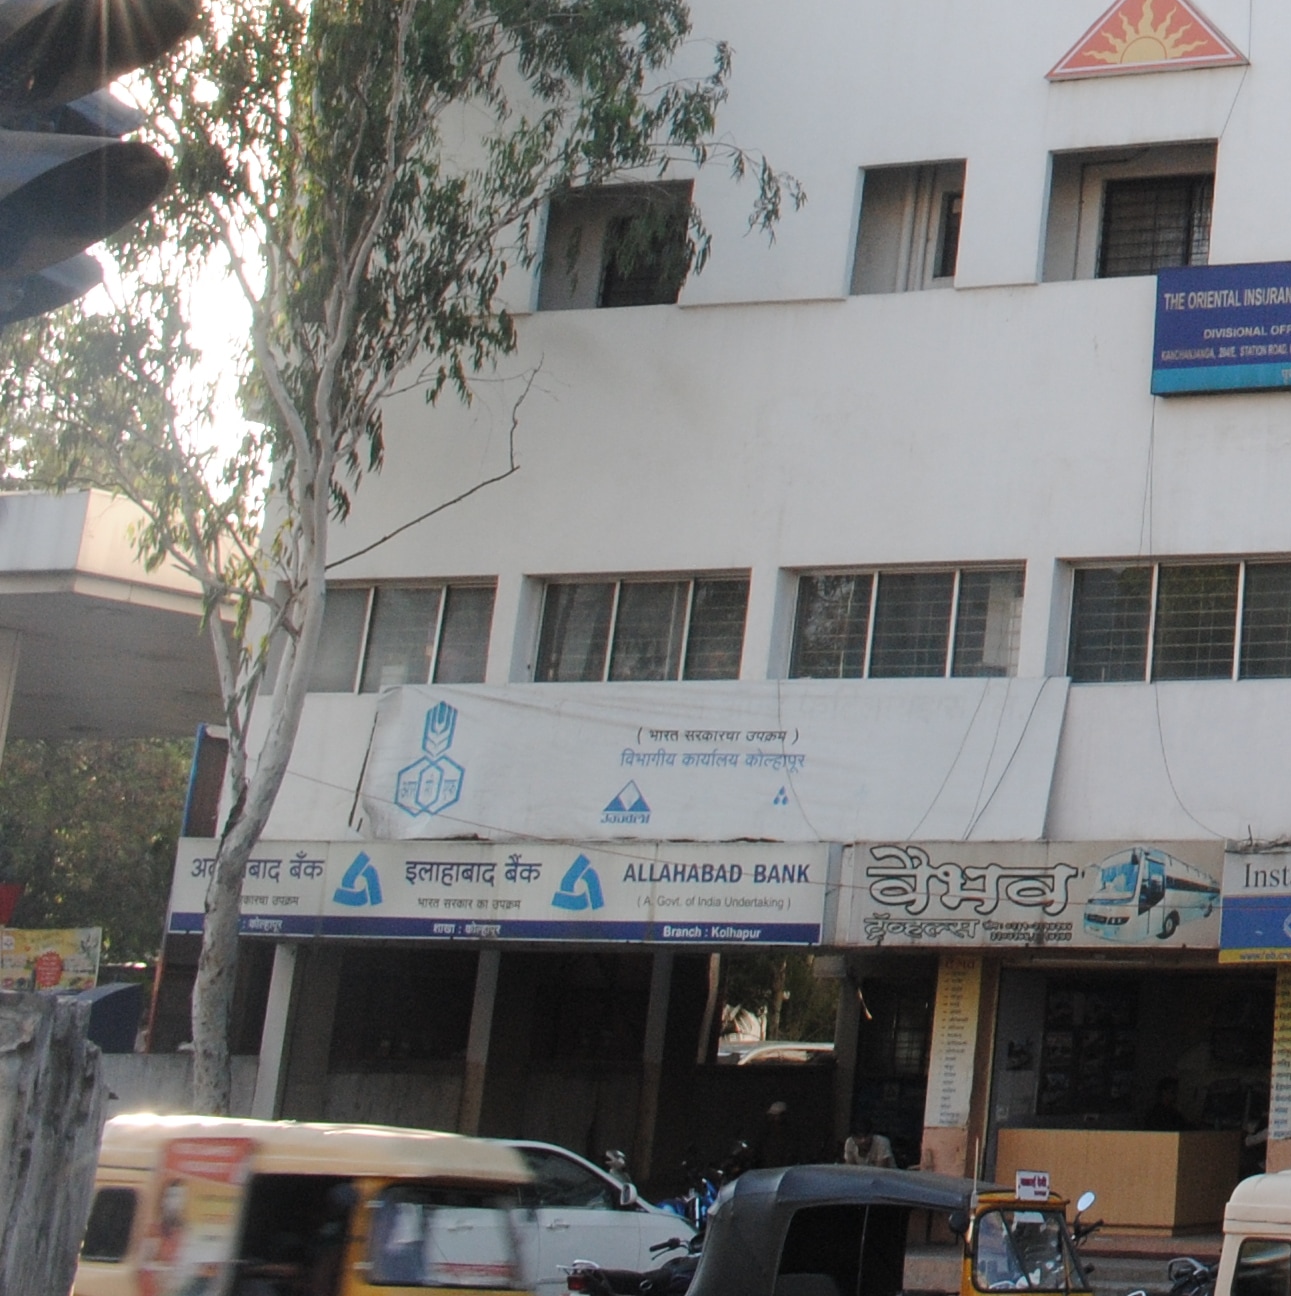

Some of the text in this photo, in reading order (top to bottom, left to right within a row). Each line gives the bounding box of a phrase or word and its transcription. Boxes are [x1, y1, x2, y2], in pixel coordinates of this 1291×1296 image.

[1164, 293, 1185, 310] THE
[1187, 289, 1241, 309] ORIENTAL
[1203, 325, 1268, 340] DIVISIONAL
[649, 730, 679, 742] भारत
[746, 730, 787, 743] उपक्रम
[620, 747, 805, 773] विभागीय कार्यालय कोल्हापूर
[405, 853, 542, 887] इलाहाबाद बैंक
[622, 863, 811, 884] ALLAHABAD BANK
[865, 844, 1078, 916] वैभव
[418, 897, 440, 909] भारत
[443, 898, 473, 909] सरकार
[686, 895, 696, 907] of
[698, 896, 721, 908] India
[724, 897, 784, 910] Undertaking
[663, 925, 702, 938] Branch
[711, 926, 762, 941] Kolhapur
